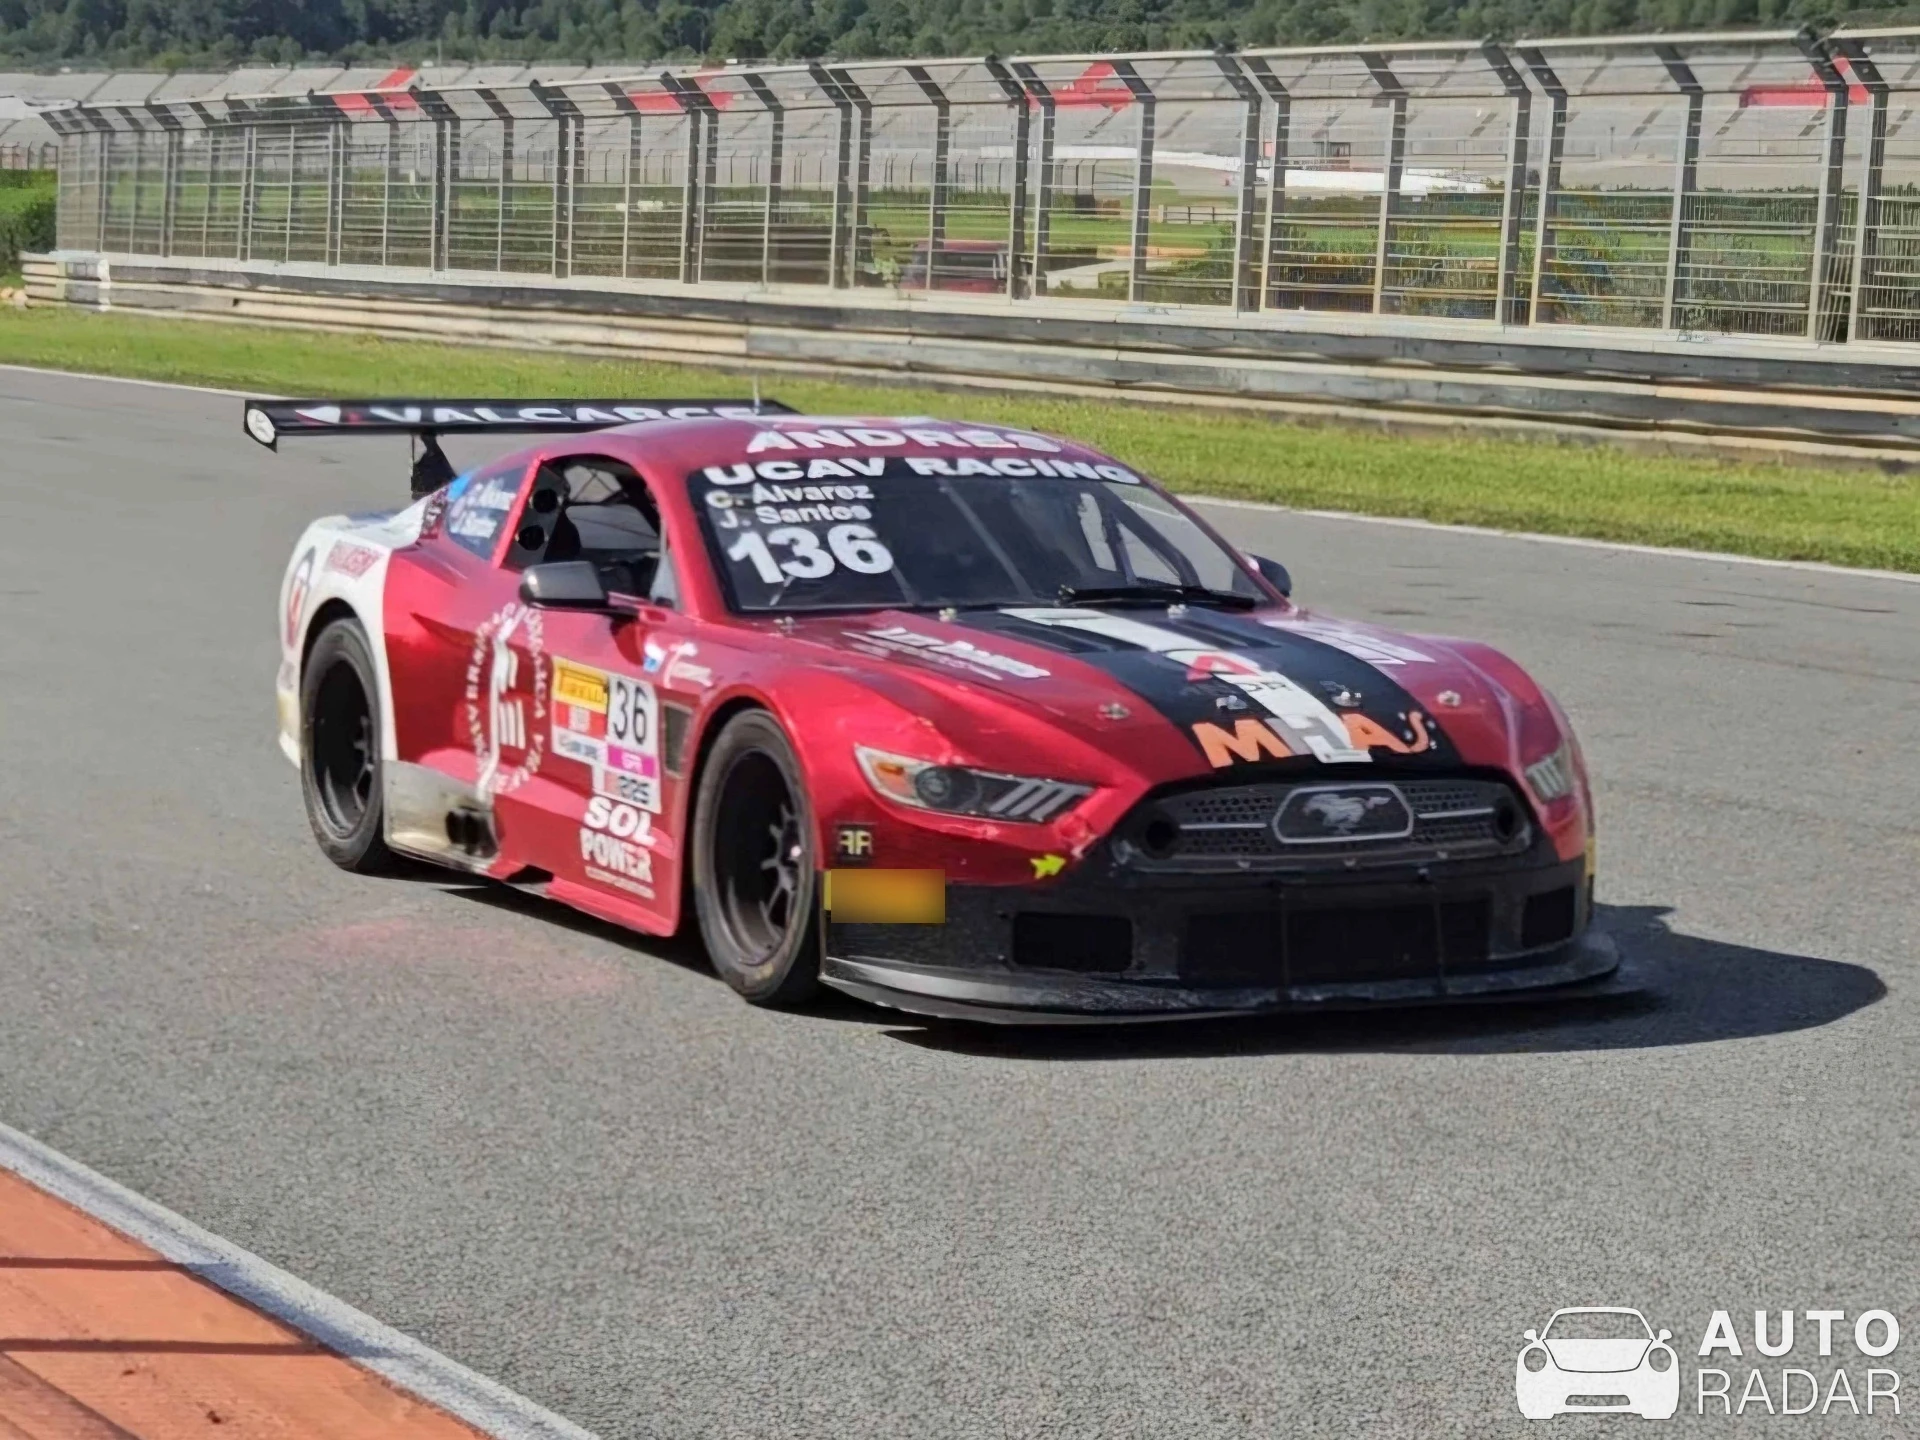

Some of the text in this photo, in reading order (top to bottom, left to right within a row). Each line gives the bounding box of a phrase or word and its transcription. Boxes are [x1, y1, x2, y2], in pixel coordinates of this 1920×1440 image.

[703, 456, 1141, 486] UCAV RACING
[705, 489, 745, 509] C.
[720, 503, 873, 529] J. Santos
[727, 523, 894, 584] 136
[612, 680, 649, 746] 36
[583, 795, 657, 848] SOL
[580, 827, 654, 885] POWER
